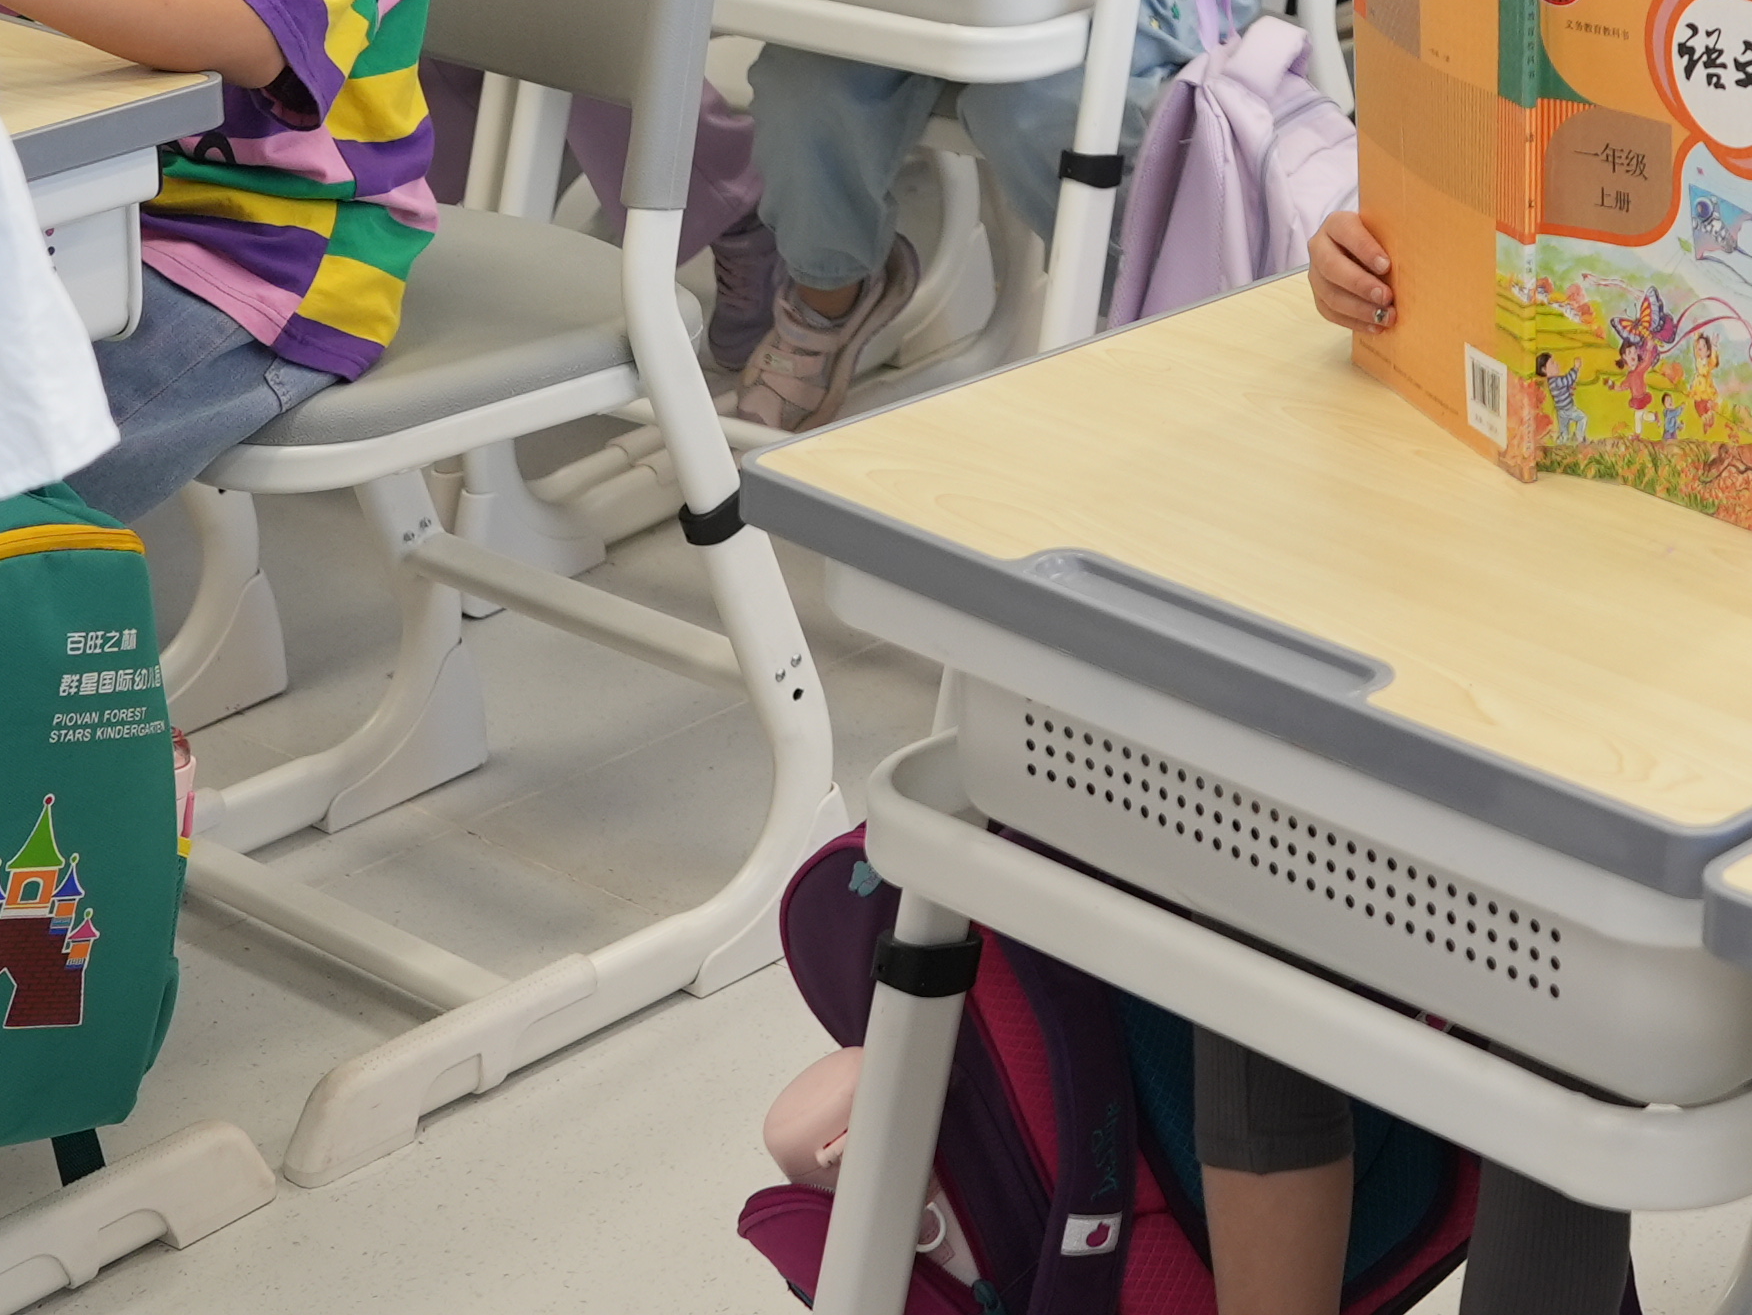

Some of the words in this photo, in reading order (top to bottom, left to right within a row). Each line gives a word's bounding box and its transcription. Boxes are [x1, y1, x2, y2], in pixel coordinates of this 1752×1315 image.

[1565, 19, 1630, 41] 义务教育教科书
[1574, 142, 1648, 181] 一年级
[1595, 186, 1632, 213] 上册
[53, 711, 99, 726] PIOVAN
[103, 707, 147, 723] FOREST
[49, 728, 92, 743] STARS
